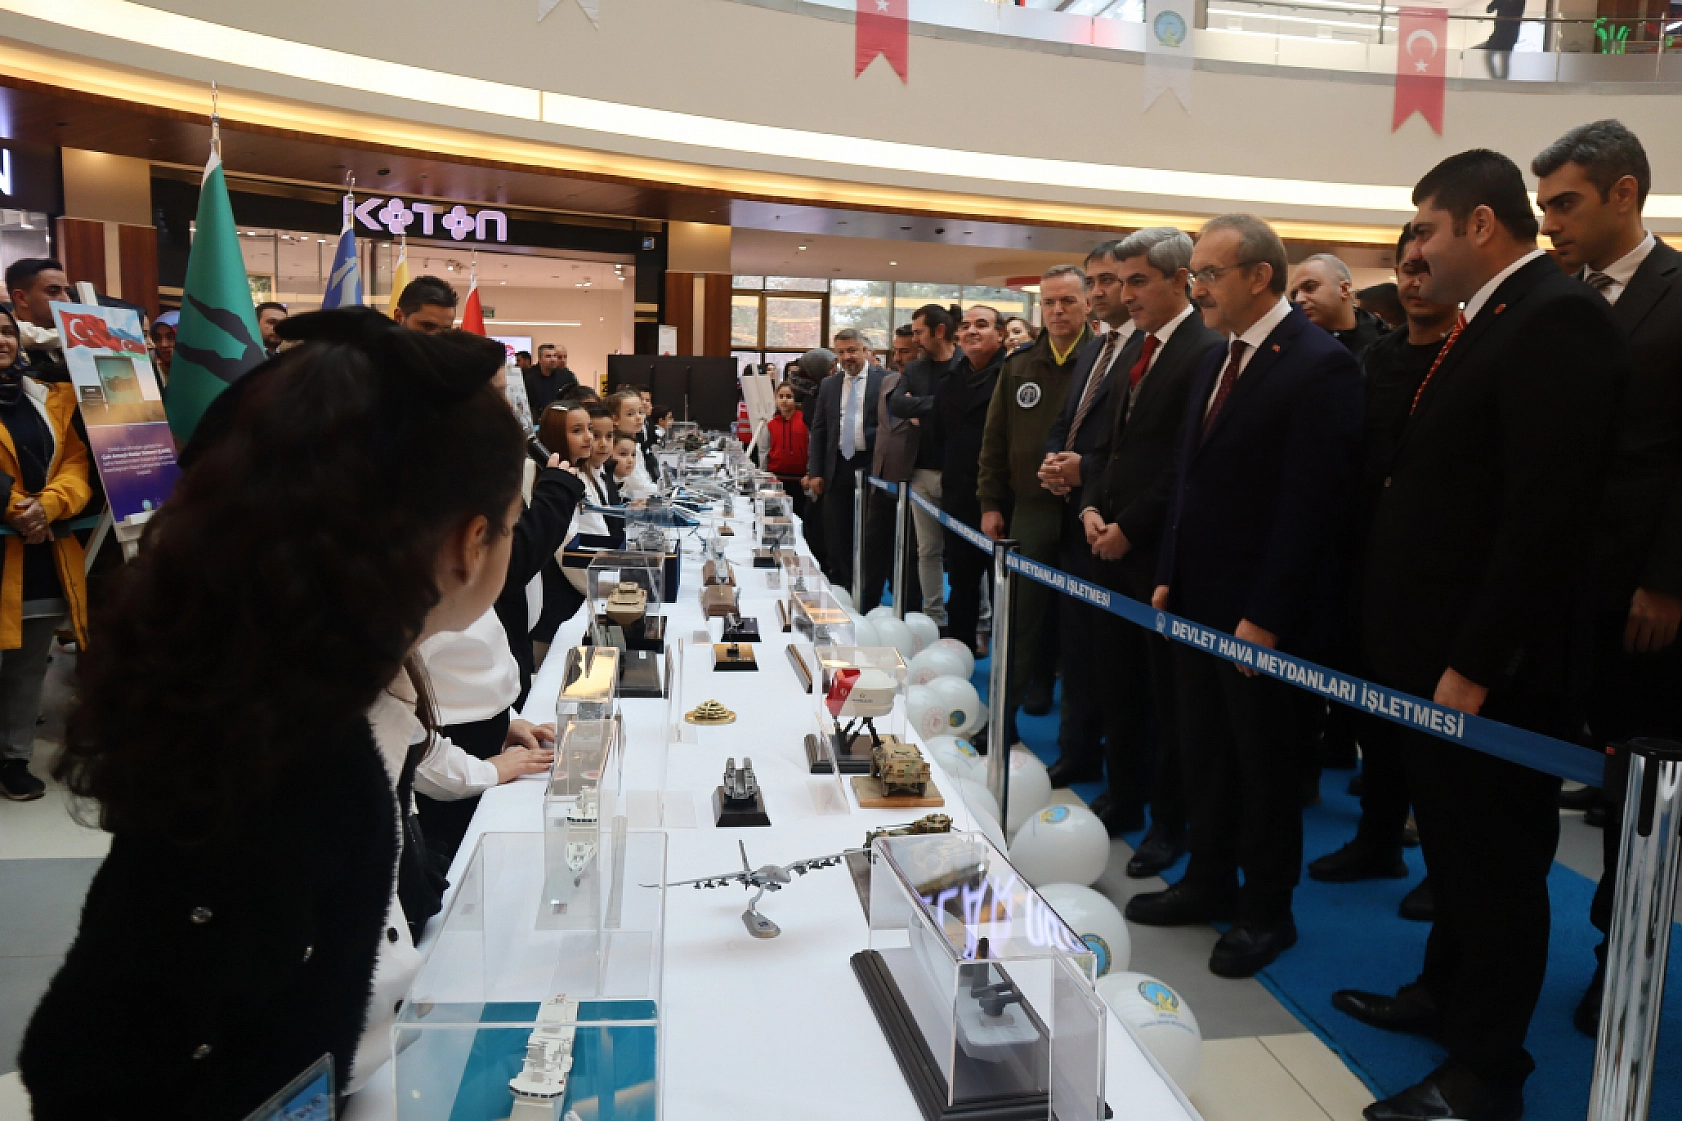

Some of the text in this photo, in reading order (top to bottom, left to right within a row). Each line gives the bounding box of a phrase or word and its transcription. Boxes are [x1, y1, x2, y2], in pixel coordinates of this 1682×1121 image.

[1171, 619, 1465, 739] DEVLET HAVA MEYDANLARI İŞLETMESİ
